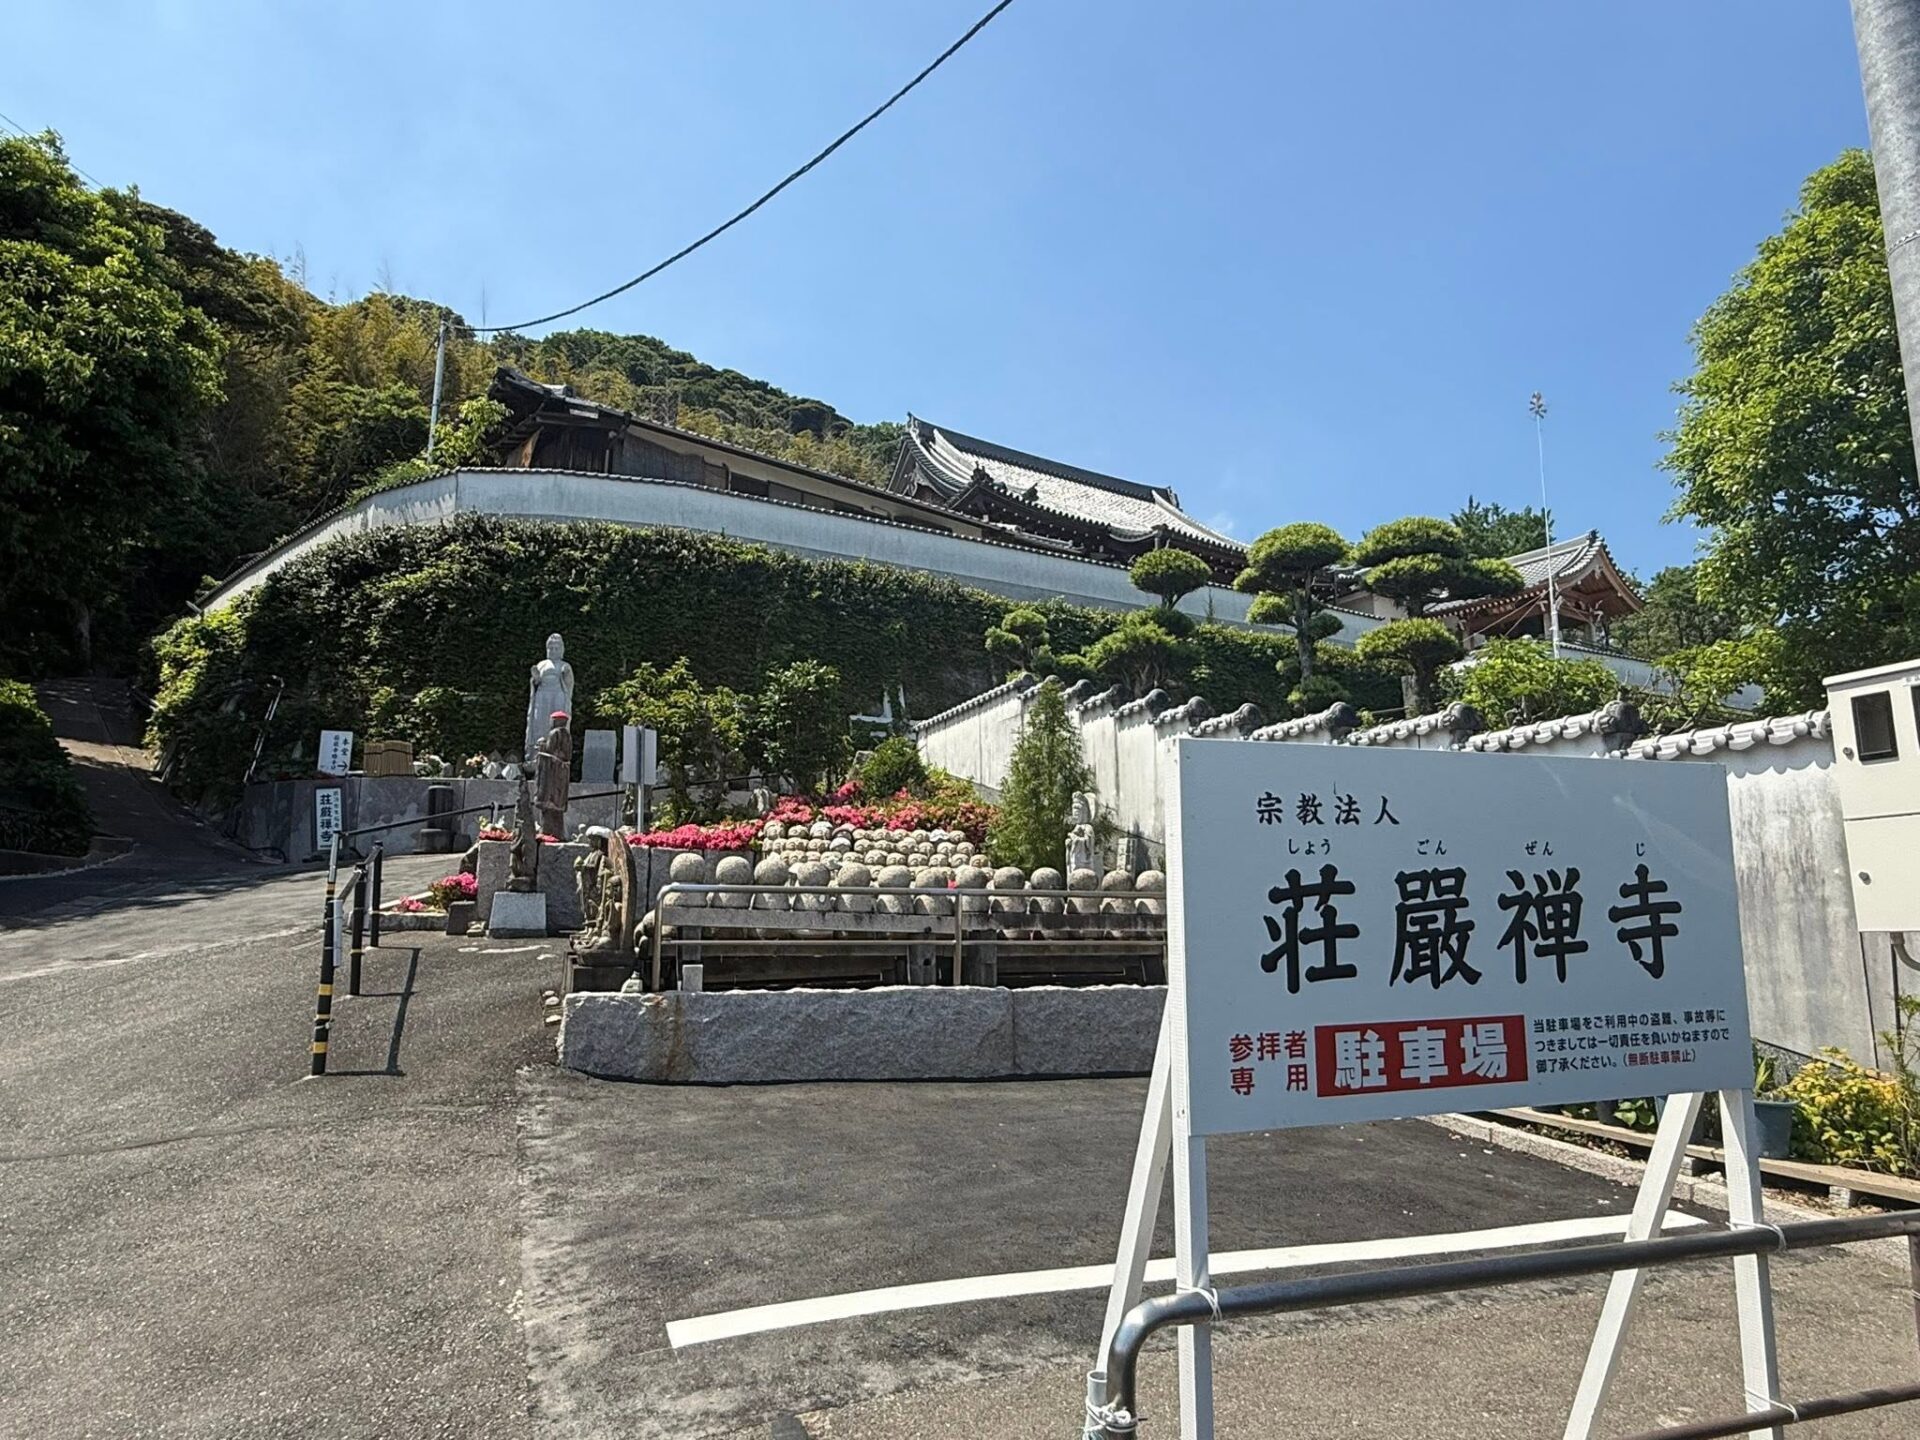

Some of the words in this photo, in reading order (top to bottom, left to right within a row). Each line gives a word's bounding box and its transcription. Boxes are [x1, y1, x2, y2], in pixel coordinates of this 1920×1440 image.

[1256, 793, 1400, 826] 宗教法人
[1287, 837, 1332, 856] しょう
[1416, 838, 1448, 856] ごん
[1524, 840, 1555, 857] ぜん
[1635, 842, 1647, 857] じ
[1533, 1009, 1726, 1034] 当駐車場をご利用中の盗難、事故等に
[1229, 1030, 1308, 1063] 参拝者
[1534, 1028, 1730, 1053] つきましては一切責任を負いかねますので
[1334, 1022, 1508, 1090] 駐車場
